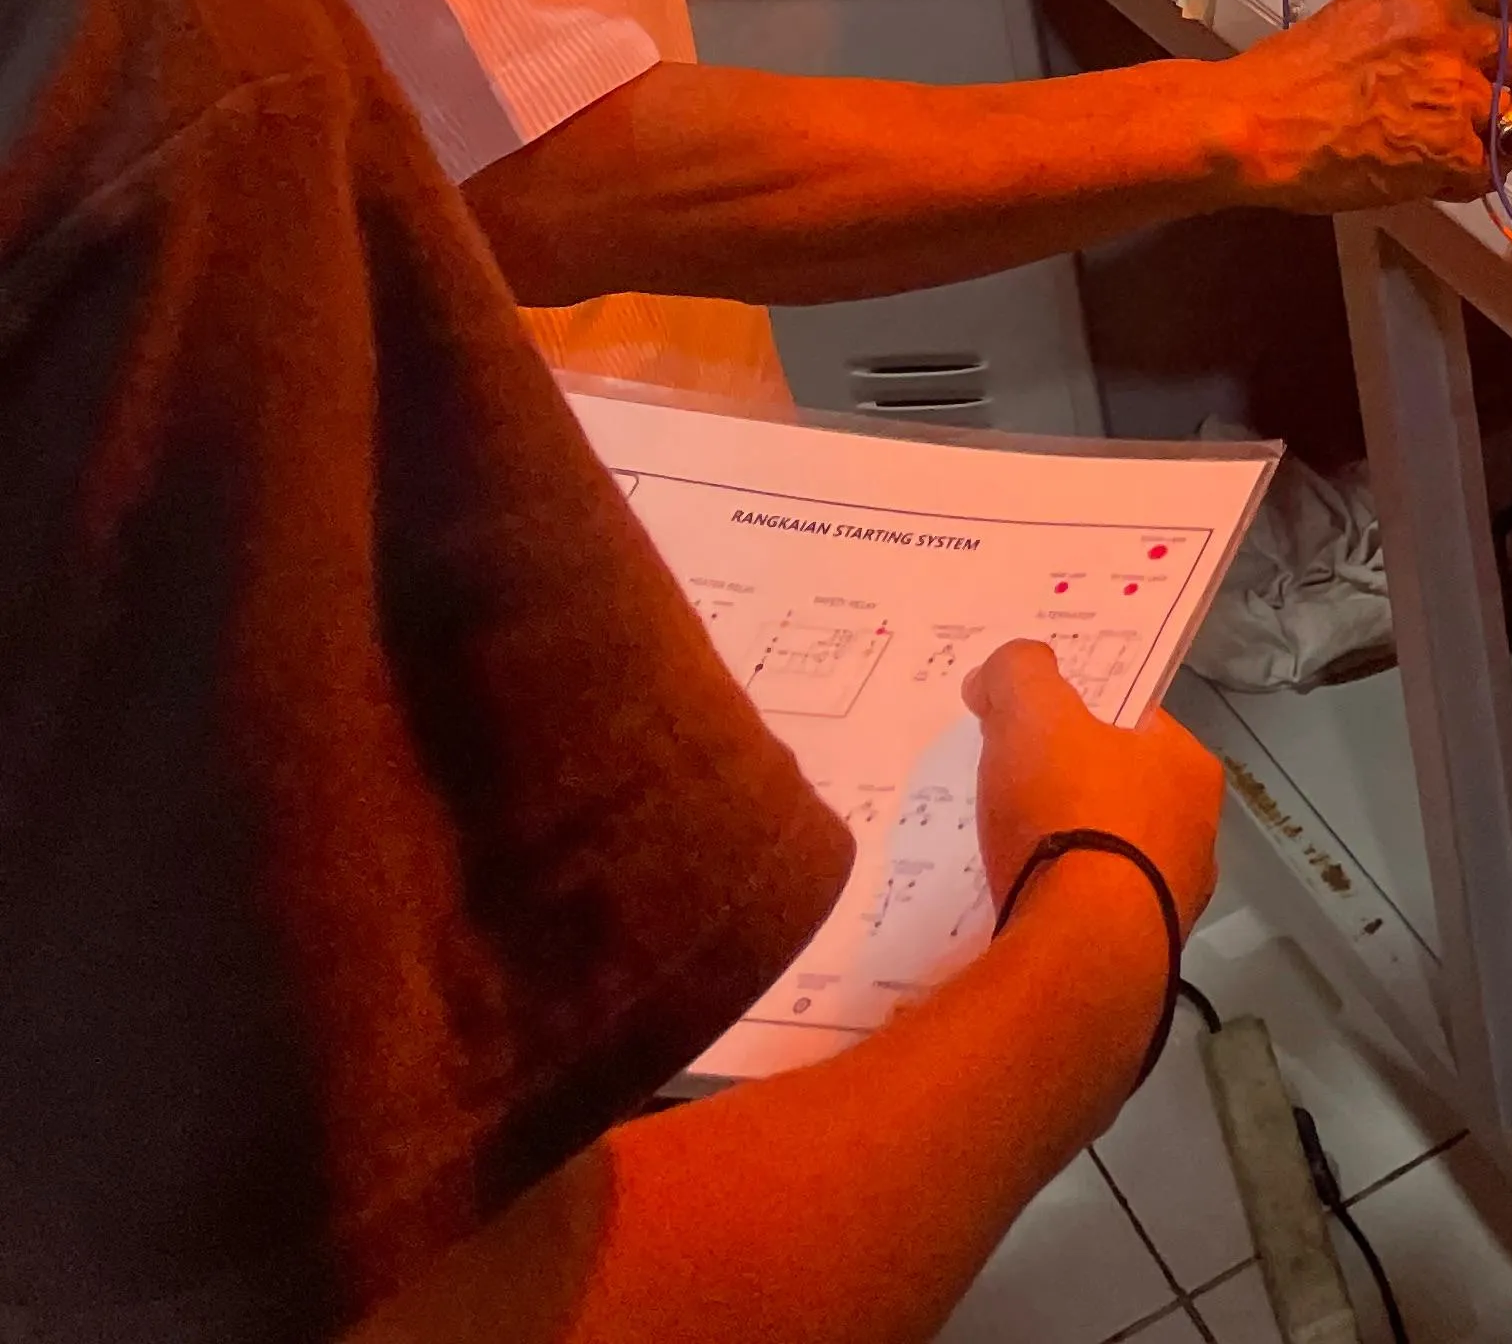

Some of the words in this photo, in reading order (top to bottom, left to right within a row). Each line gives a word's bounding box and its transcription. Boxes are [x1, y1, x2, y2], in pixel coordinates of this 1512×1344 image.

[731, 509, 832, 535] RANGKAIAN
[833, 523, 914, 546] STARTING
[915, 533, 980, 552] SYSTEM
